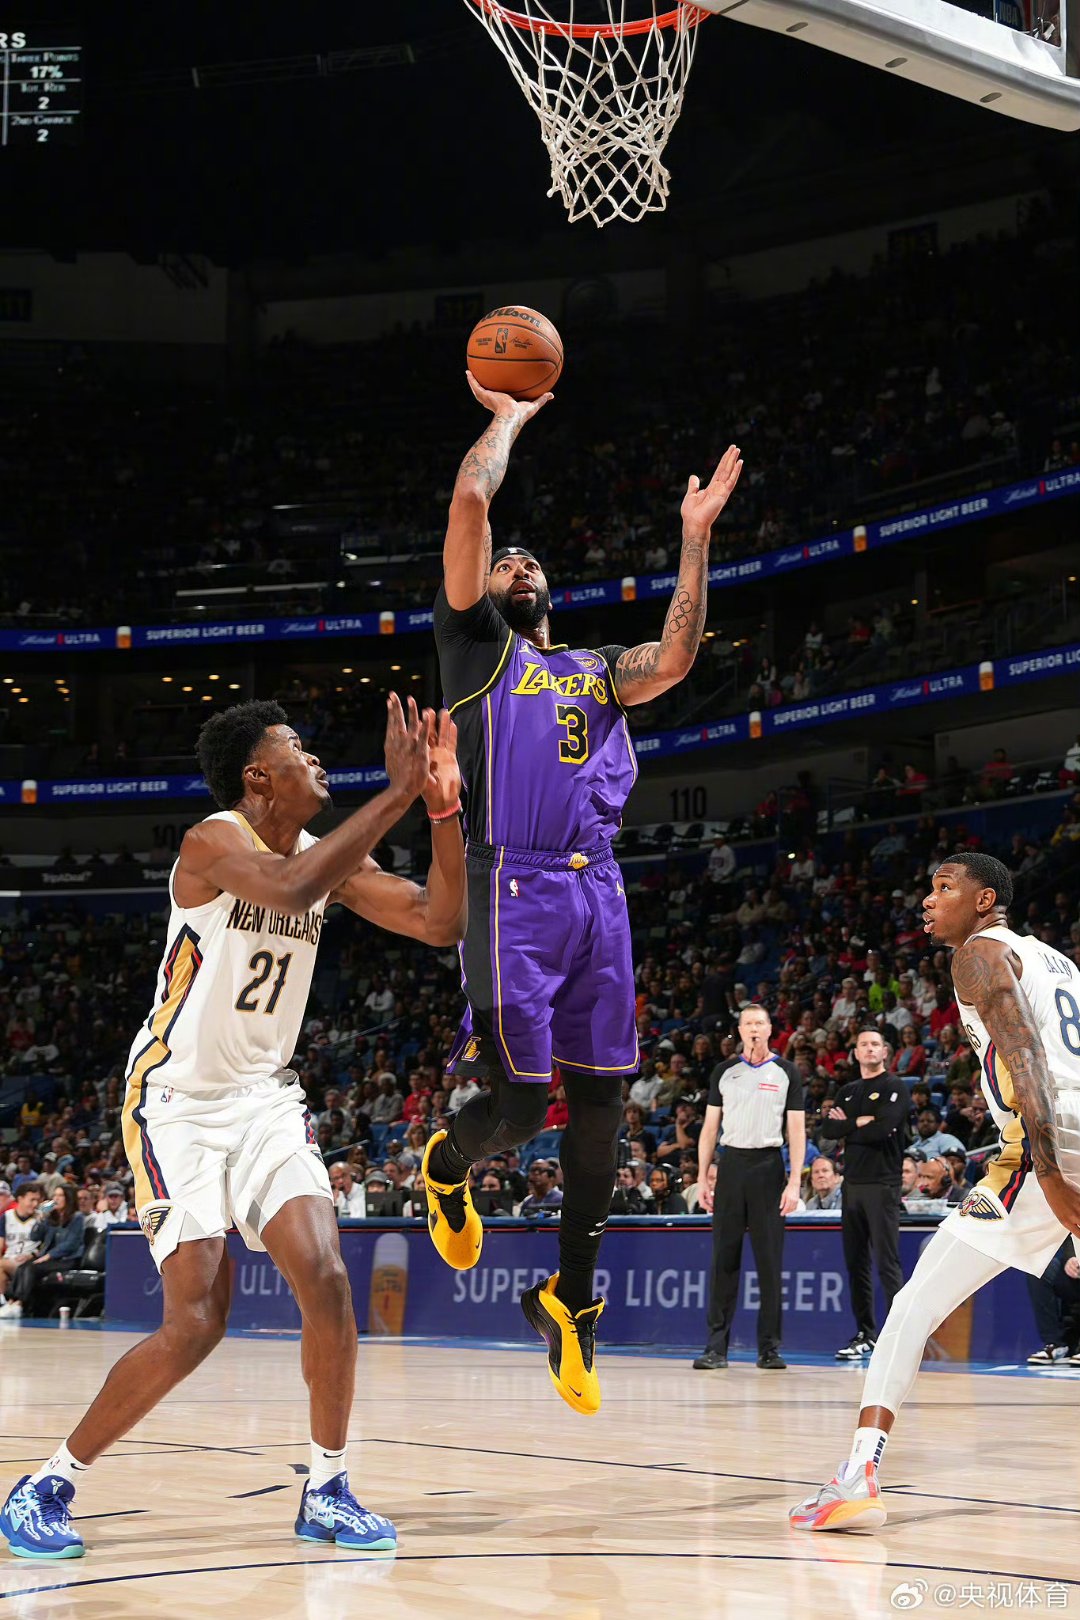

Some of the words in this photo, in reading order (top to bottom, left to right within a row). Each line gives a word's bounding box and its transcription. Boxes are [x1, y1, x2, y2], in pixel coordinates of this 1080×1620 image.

[30, 65, 63, 78] 17%
[38, 97, 50, 110] 2
[36, 129, 49, 142] 2
[879, 514, 928, 537] SUPERIOR
[929, 505, 960, 524] LIGHT
[961, 498, 989, 515] BEER
[808, 540, 840, 556] ULTRA
[708, 566, 737, 581] LIGHT
[738, 560, 763, 576] BEER
[571, 587, 606, 601] ULTRA
[146, 628, 200, 640] SUPERIOR
[202, 625, 234, 638] LIGHT
[236, 624, 265, 635] BEER
[325, 619, 363, 631] ULTRA
[63, 633, 100, 645] ULTRA
[1009, 653, 1063, 676] SUPERIOR
[510, 662, 609, 705] LAKERS
[929, 675, 964, 692] ULTRA
[773, 705, 820, 725] SUPERIOR
[821, 698, 849, 716] LIGHT
[850, 693, 876, 709] BEER
[555, 703, 590, 765] 3
[707, 724, 737, 740] ULTRA
[635, 738, 661, 752] BEER
[52, 782, 104, 795] SUPERIOR
[106, 781, 138, 794] LIGHT
[140, 780, 169, 792] BEER
[670, 786, 707, 821] 110
[226, 899, 266, 933] NEW
[235, 949, 293, 1015] 21
[1054, 987, 1080, 1059] 8
[240, 1263, 293, 1296] ULT
[453, 1267, 612, 1305] SUPER
[626, 1268, 706, 1309] LIGH
